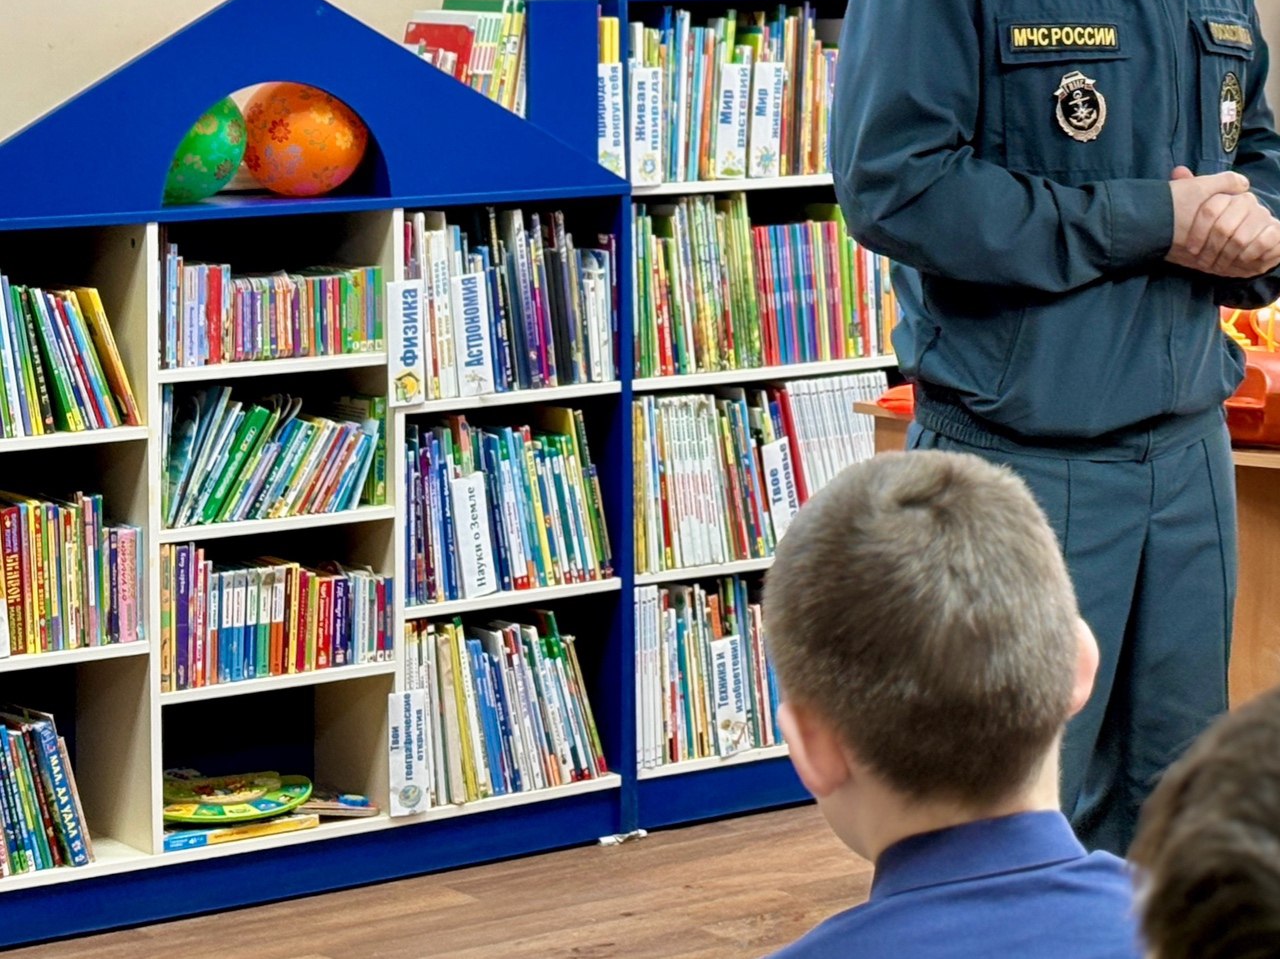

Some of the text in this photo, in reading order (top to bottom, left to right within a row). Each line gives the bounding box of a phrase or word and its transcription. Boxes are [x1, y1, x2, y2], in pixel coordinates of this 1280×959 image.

[1013, 27, 1116, 46] МЧС РОССИИ
[609, 66, 621, 147] вокруг тебя
[635, 81, 645, 141] Живая
[651, 70, 659, 150] природа
[720, 89, 734, 125] Мир
[737, 67, 748, 148] растений
[755, 88, 768, 116] Мир
[772, 67, 783, 138] животных
[400, 288, 418, 367] Физика
[462, 276, 484, 367] Астрономия
[770, 468, 783, 506] Твое
[468, 486, 487, 587] Науки о Земле
[716, 651, 729, 709] Техника и
[730, 639, 743, 713] изобретения
[390, 726, 400, 751] Твои
[404, 693, 413, 781] географические
[416, 709, 424, 761] открытия
[56, 787, 68, 805] ДА
[60, 804, 78, 839] УДАЛ
